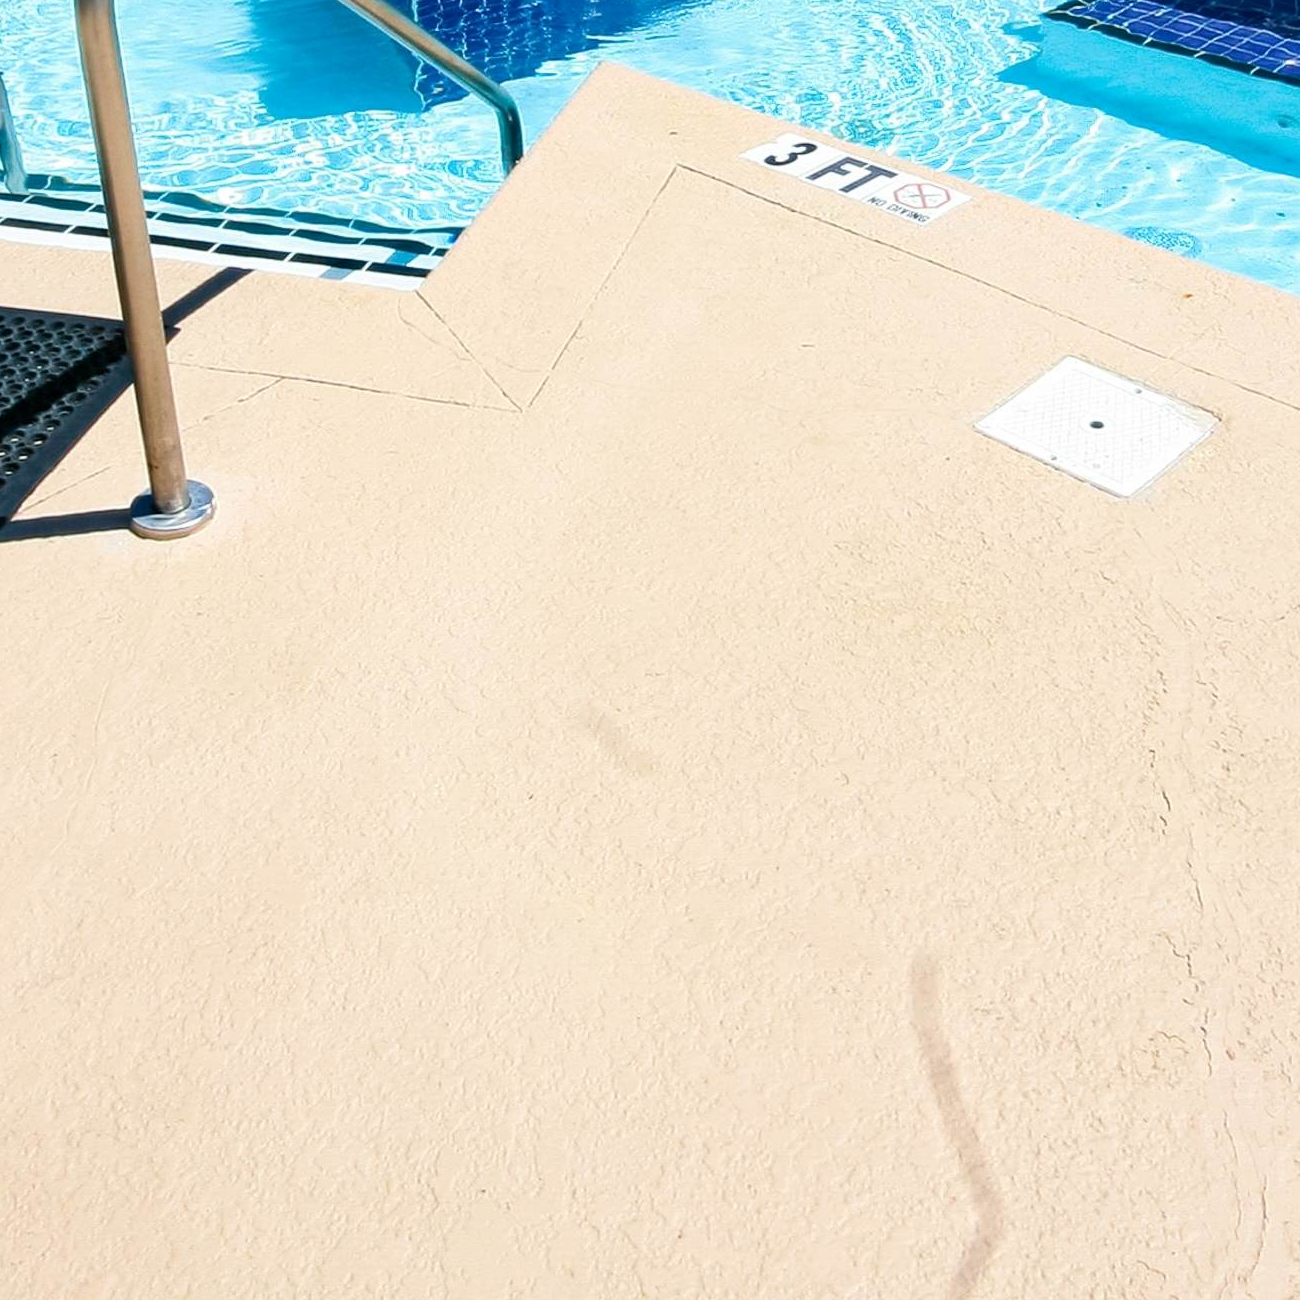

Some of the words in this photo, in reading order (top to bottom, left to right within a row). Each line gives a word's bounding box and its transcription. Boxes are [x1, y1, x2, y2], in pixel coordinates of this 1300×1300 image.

[763, 142, 818, 167] 3
[805, 156, 898, 194] FT
[866, 196, 888, 207] NO
[886, 203, 931, 223] DIVING
